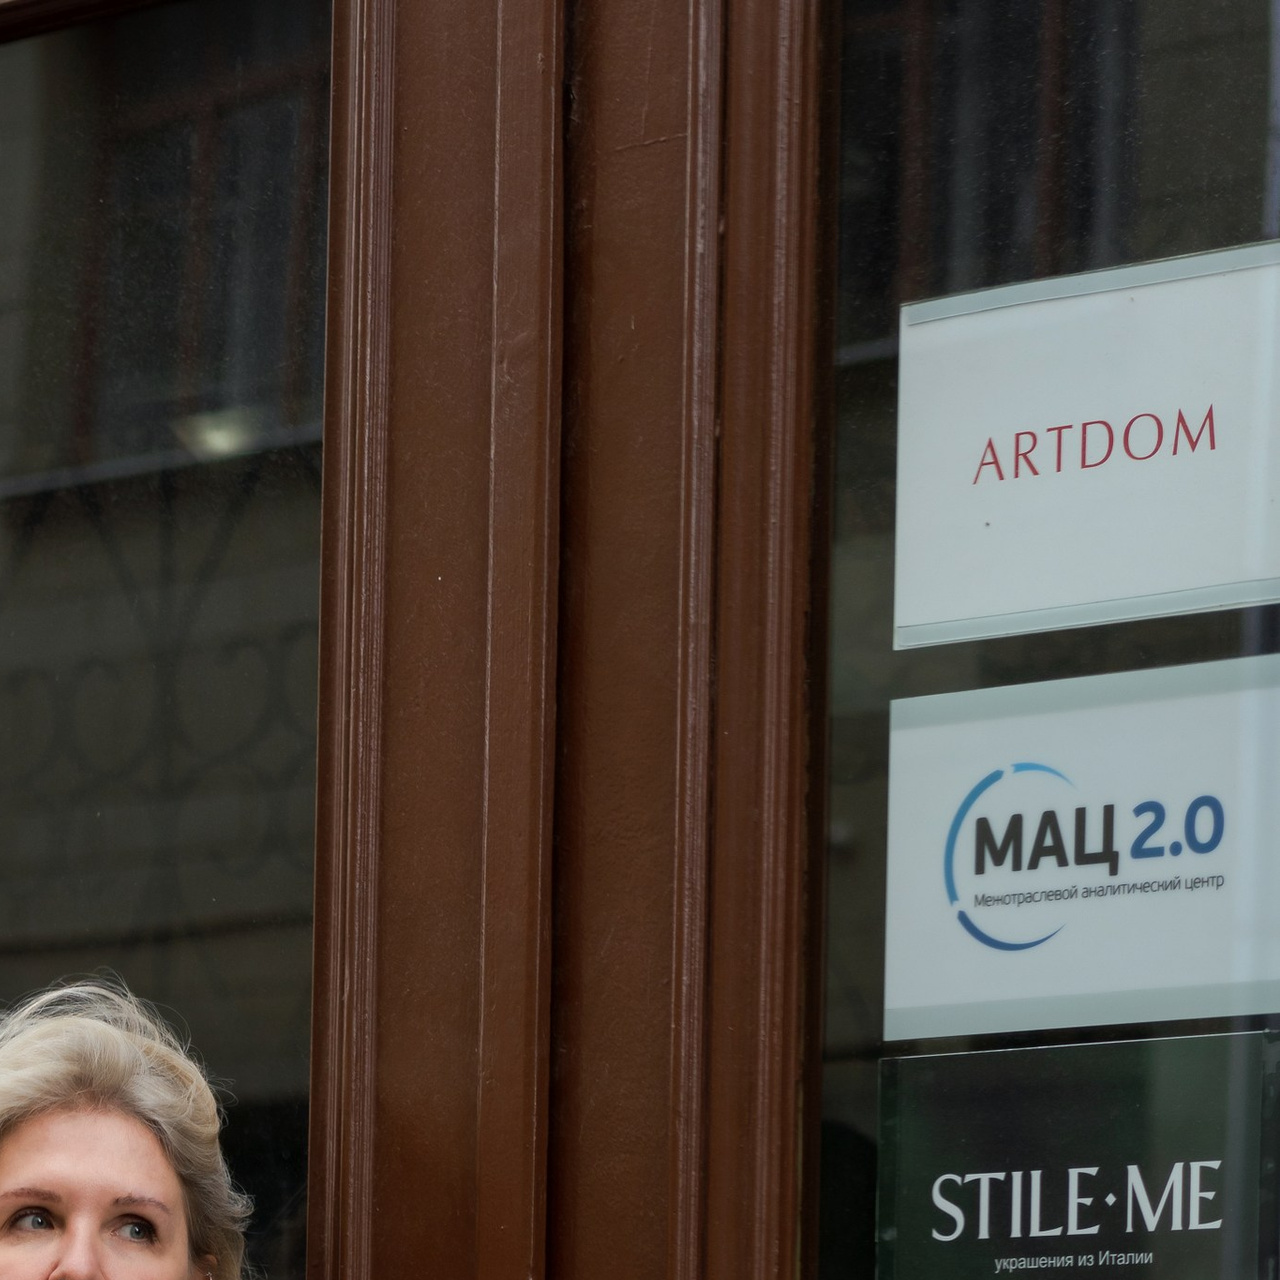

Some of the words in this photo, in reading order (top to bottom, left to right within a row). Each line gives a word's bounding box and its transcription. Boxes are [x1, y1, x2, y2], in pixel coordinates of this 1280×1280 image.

[972, 403, 1217, 485] ARTDOM
[974, 804, 1119, 876] МАЦ
[1129, 795, 1224, 859] 2.0
[973, 886, 1078, 908] Межотраслевой
[1081, 876, 1181, 899] аналитический
[1184, 873, 1225, 891] центр
[994, 1255, 1074, 1274] украшения
[1077, 1254, 1095, 1268] из
[1098, 1250, 1153, 1267] Италии
